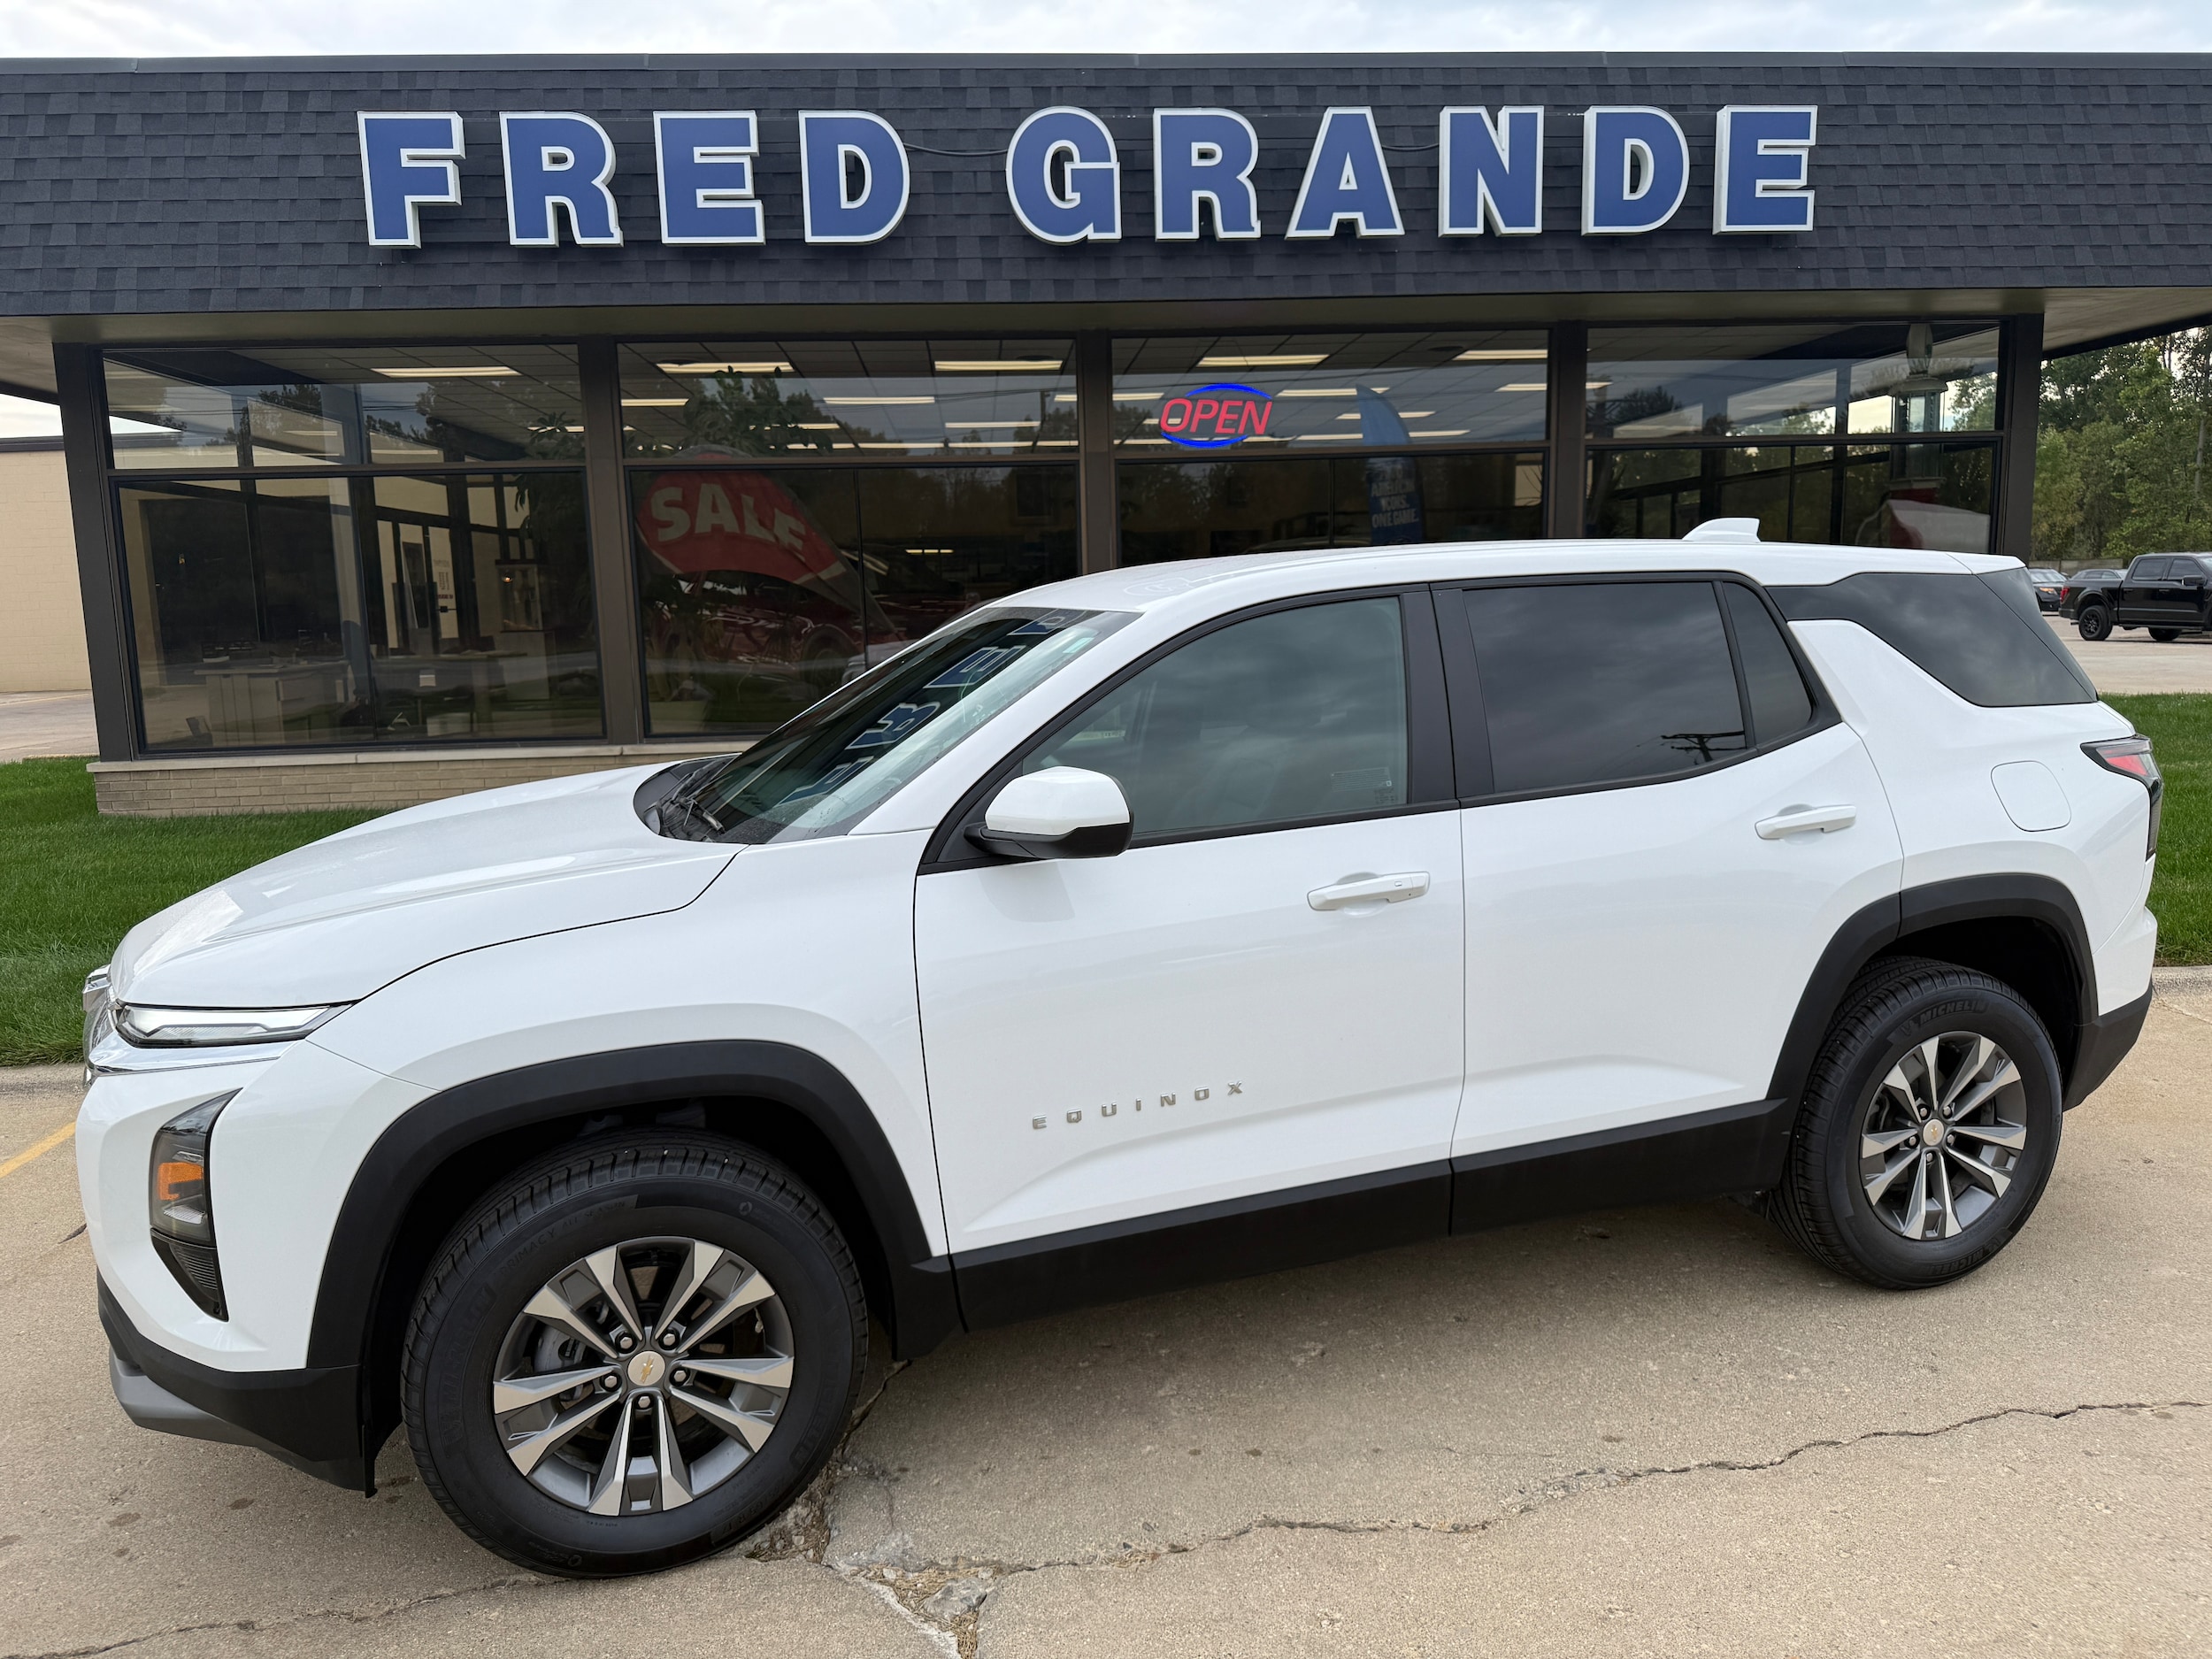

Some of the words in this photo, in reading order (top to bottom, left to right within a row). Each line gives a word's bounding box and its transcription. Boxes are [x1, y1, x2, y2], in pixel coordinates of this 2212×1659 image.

[357, 111, 910, 250] FRED
[1005, 104, 1819, 243] GRANDE
[1159, 398, 1272, 434] OPEN
[649, 482, 806, 551] SALE
[1919, 999, 1988, 1025] MICHELIN
[1032, 1080, 1243, 1130] EQUINOX
[498, 1228, 556, 1275] PRIMACY
